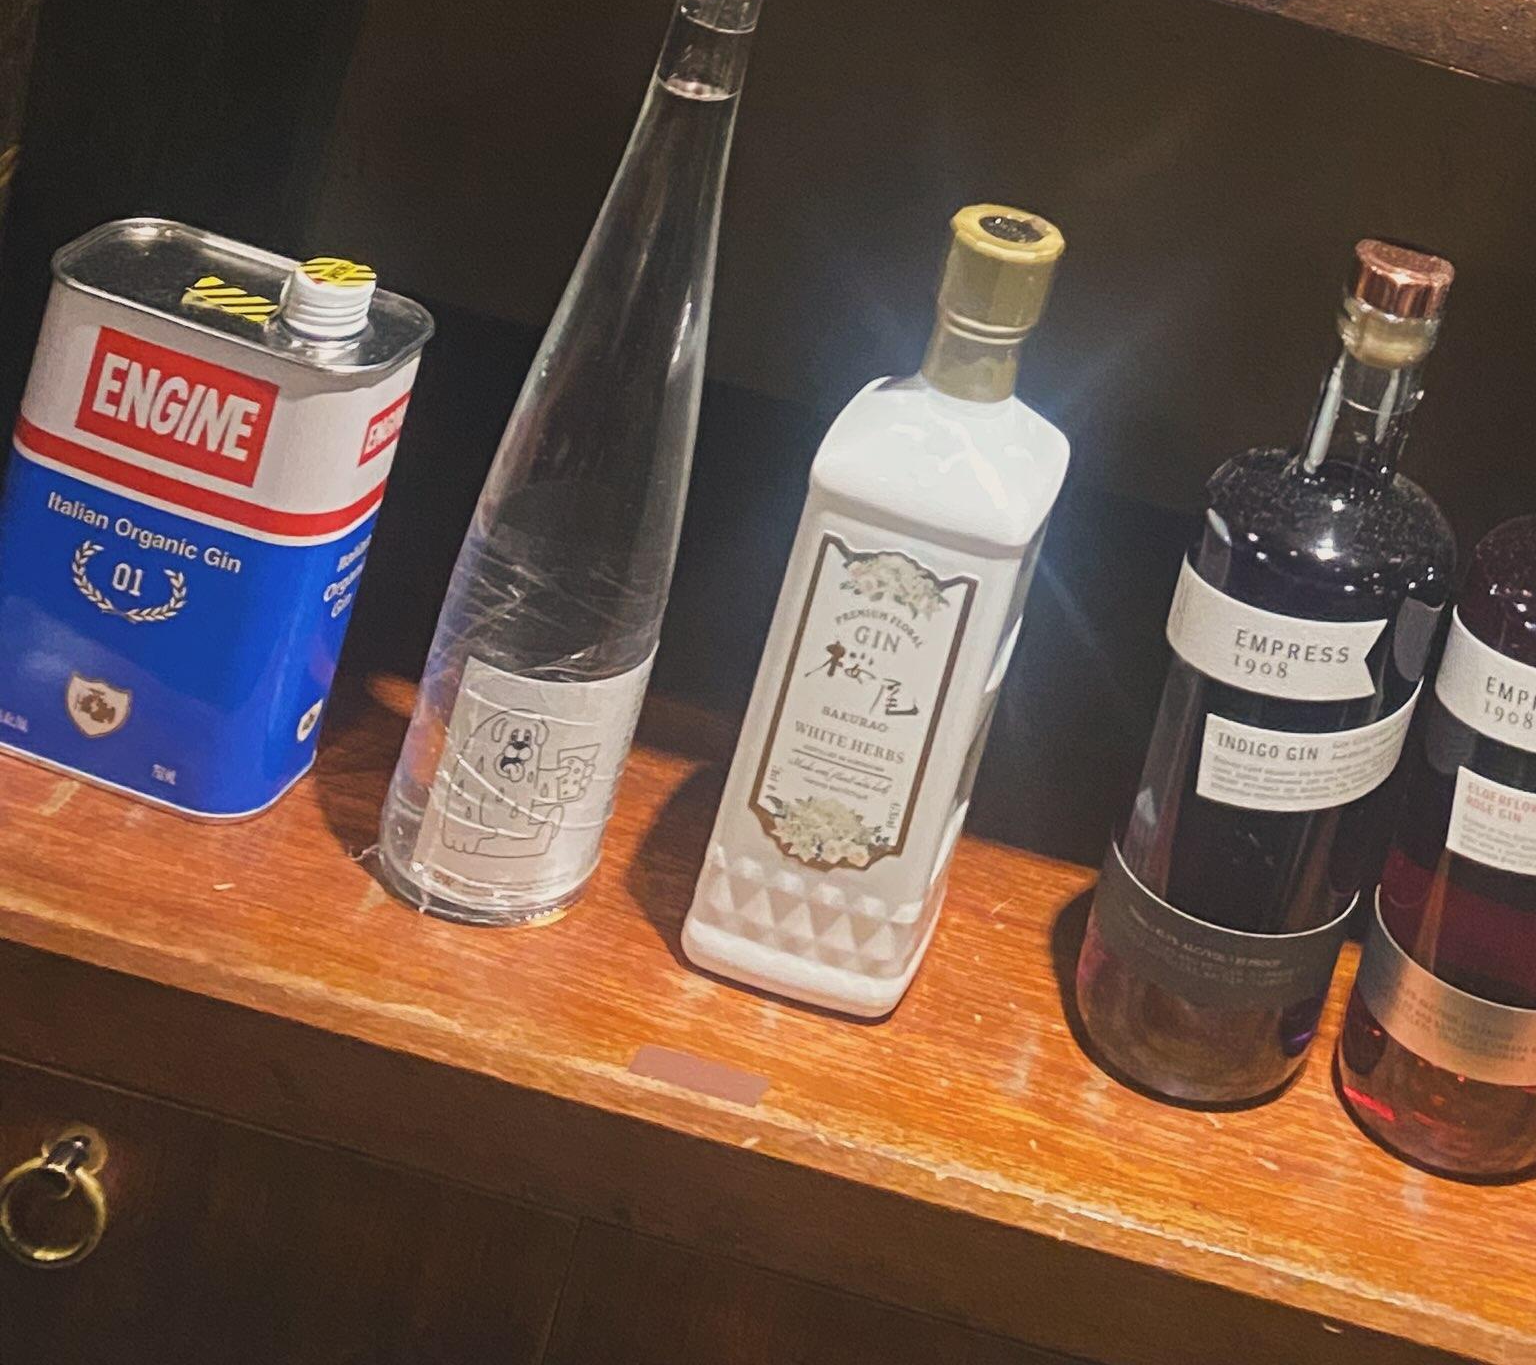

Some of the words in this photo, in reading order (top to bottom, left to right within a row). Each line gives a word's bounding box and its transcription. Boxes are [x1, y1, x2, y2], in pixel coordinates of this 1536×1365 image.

[92, 349, 262, 463] ENGINE
[46, 490, 109, 531] Italian
[114, 515, 198, 562] Organic
[203, 545, 242, 575] Gin
[111, 562, 143, 598] 01
[834, 608, 890, 626] PREMIUM
[853, 624, 903, 655] GIN
[1234, 627, 1351, 665] EMPRESS
[1232, 653, 1290, 680] 1908
[821, 705, 890, 734] SAKURAO
[1483, 699, 1536, 732] 1908
[794, 719, 849, 750] WHITE
[851, 735, 906, 766] HERBS
[1217, 731, 1280, 760] INDIGO
[1285, 745, 1321, 762] GIN
[1499, 806, 1523, 826] GIN
